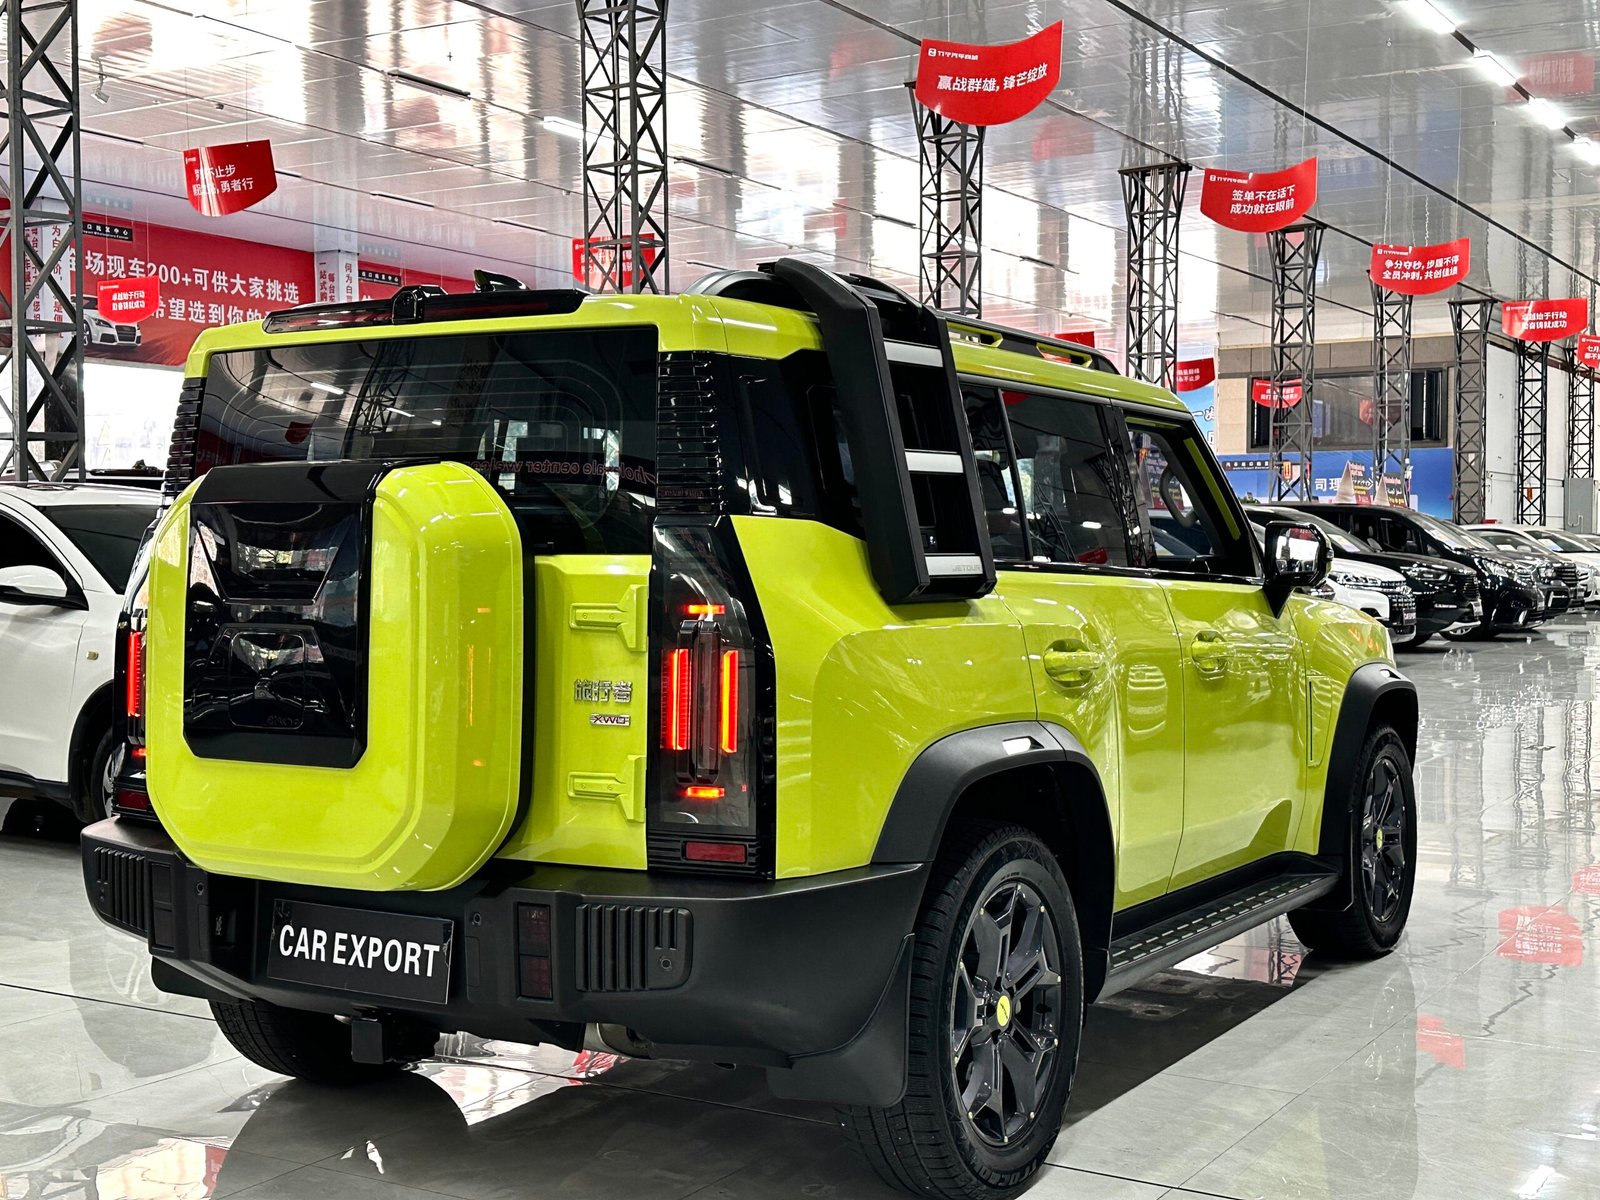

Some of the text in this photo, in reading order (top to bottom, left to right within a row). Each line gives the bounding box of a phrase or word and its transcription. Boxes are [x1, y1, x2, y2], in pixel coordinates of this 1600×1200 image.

[937, 62, 1048, 93] 赢战群雄，锋芒绽放
[1232, 184, 1296, 202] 签单不在话下
[1230, 198, 1294, 215] 成功就在眼前
[574, 679, 633, 703] 旅行者
[279, 924, 440, 978] CAR EXPORT
